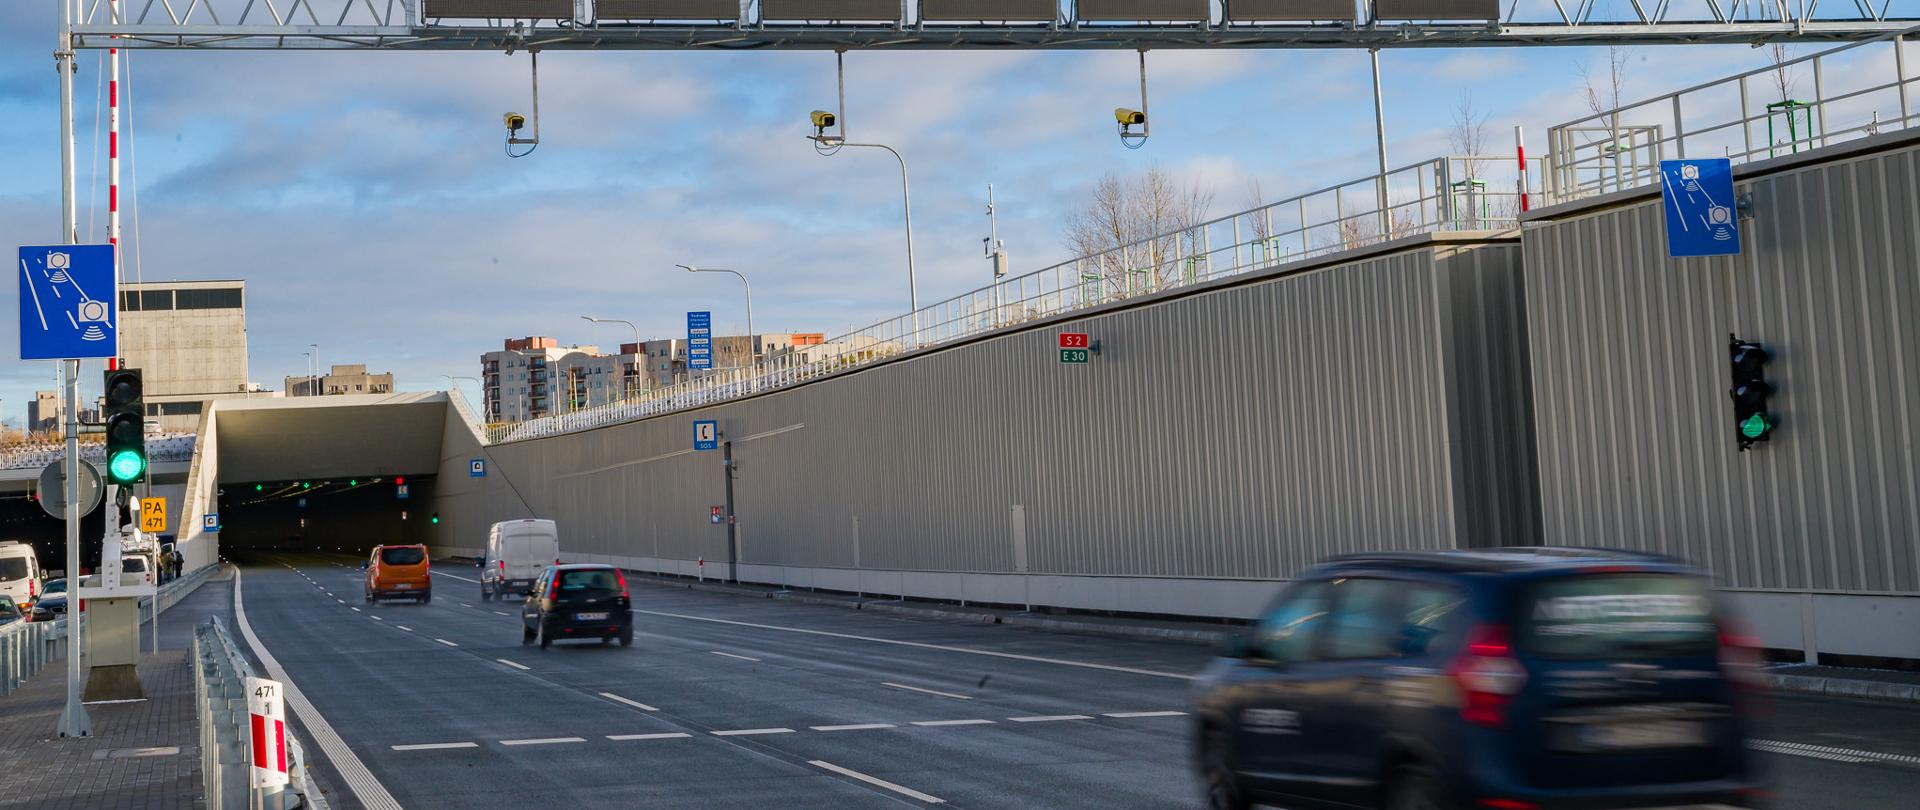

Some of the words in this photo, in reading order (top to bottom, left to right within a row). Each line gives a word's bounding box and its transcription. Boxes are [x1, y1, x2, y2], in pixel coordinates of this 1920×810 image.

[1066, 336, 1073, 346] S
[1075, 336, 1081, 346] 2
[1063, 351, 1069, 361] E
[1071, 351, 1085, 361] 30
[144, 502, 163, 514] PA
[145, 518, 163, 528] 471
[255, 685, 275, 698] 471
[264, 702, 270, 715] 1
